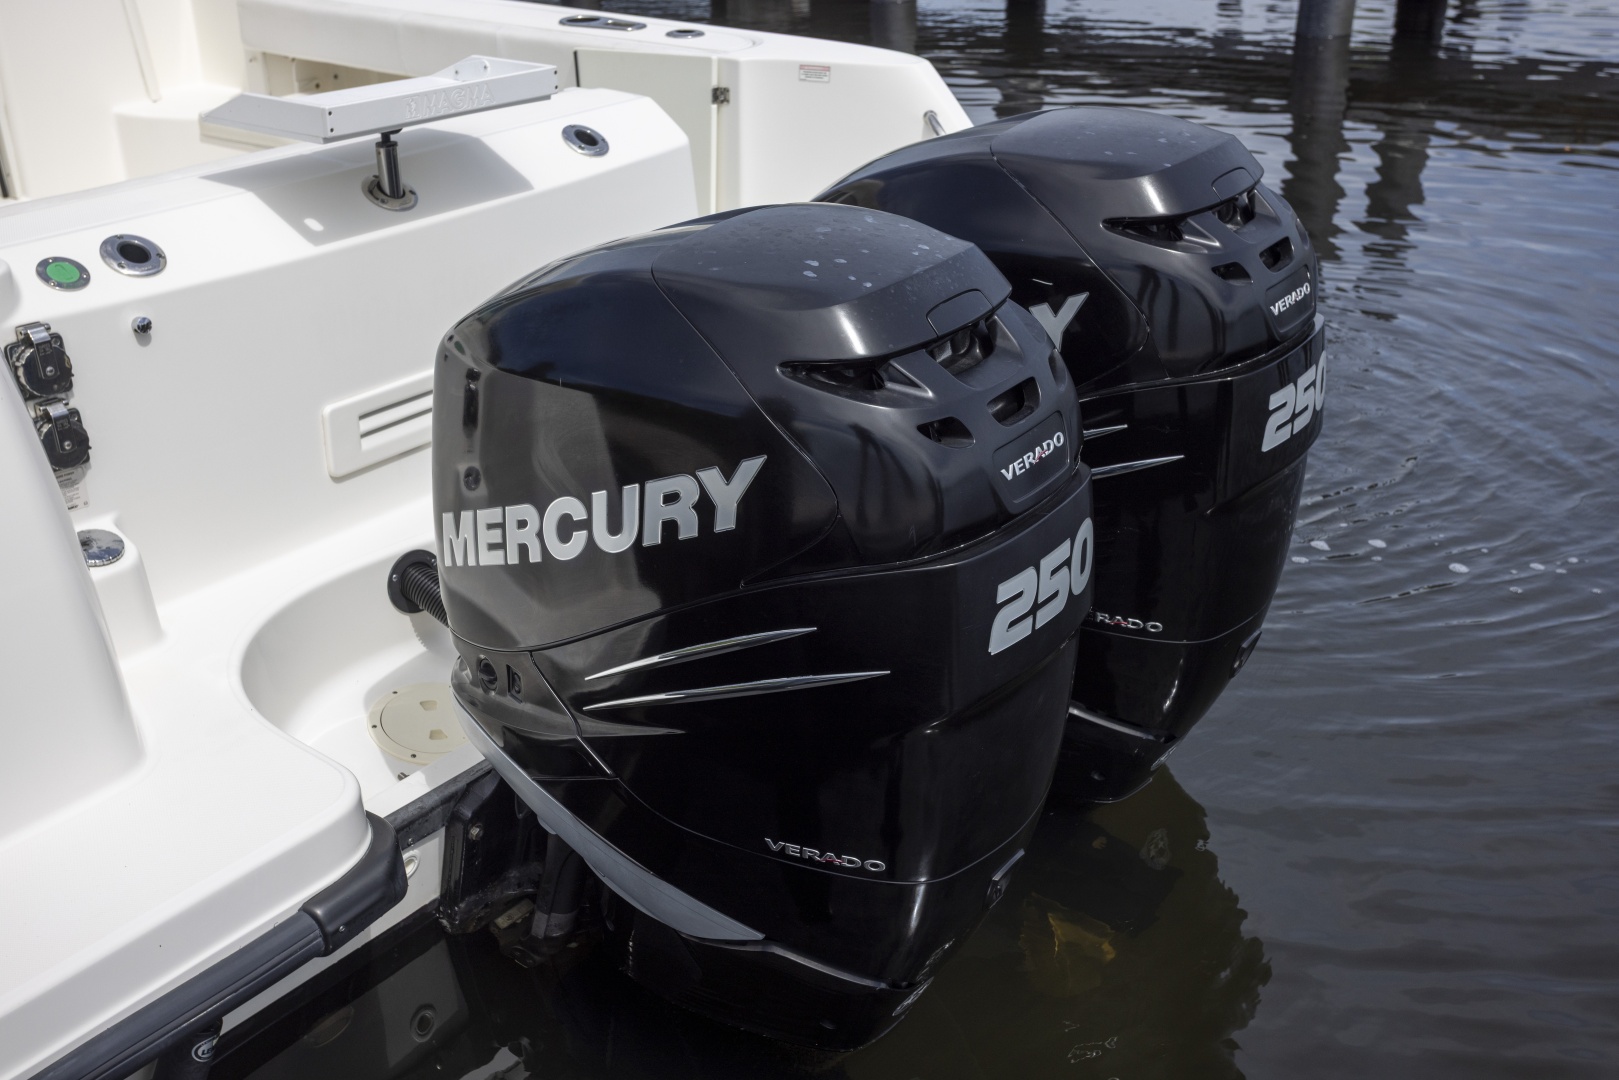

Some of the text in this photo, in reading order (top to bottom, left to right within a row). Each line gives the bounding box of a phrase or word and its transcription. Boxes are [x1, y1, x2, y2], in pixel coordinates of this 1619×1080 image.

[423, 83, 496, 118] MAGMA
[1270, 282, 1311, 316] VERADO
[1261, 350, 1326, 452] 250
[1000, 431, 1064, 480] VERADO
[442, 454, 768, 567] MERCURY
[988, 516, 1094, 655] 250
[1090, 607, 1163, 632] RADO
[764, 837, 886, 872] VERADO
